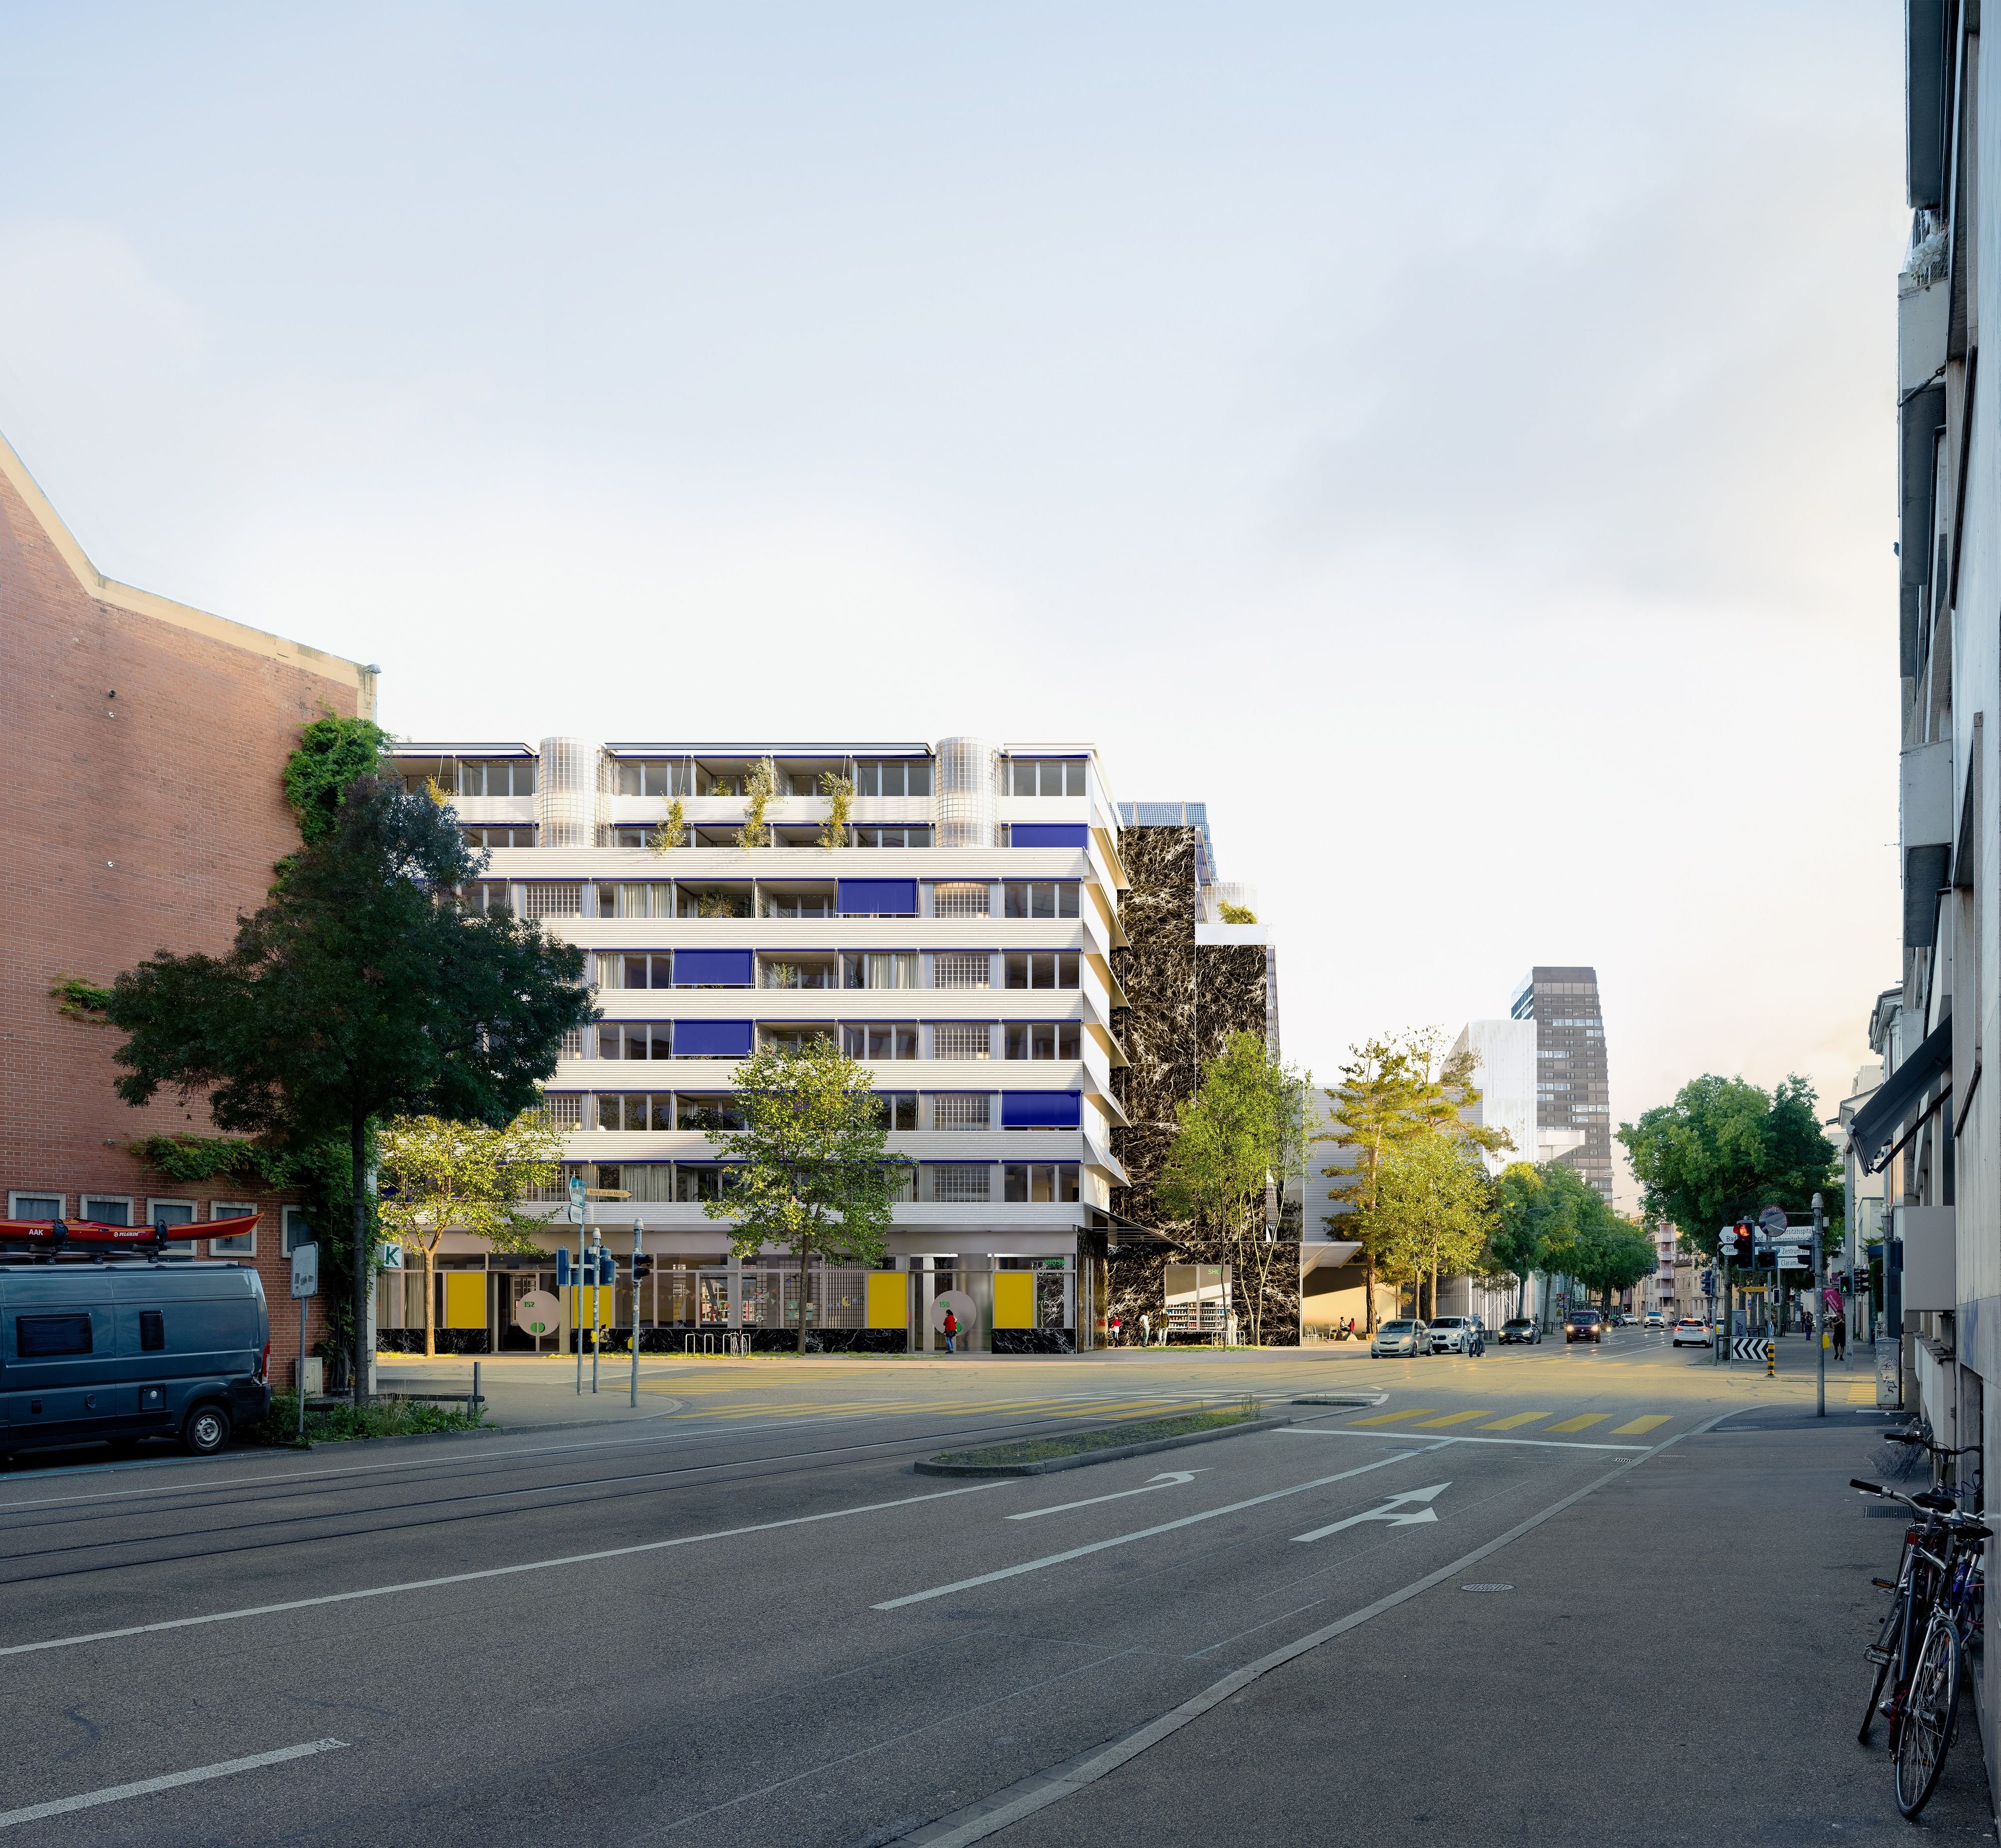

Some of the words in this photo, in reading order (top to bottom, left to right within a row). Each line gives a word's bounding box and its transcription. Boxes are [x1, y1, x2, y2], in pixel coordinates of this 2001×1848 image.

[1784, 1227, 1811, 1235] ersitätsspita
[386, 1246, 400, 1266] K
[1826, 1296, 1837, 1312] Willkomm
[1828, 1294, 1839, 1307] Herzlich
